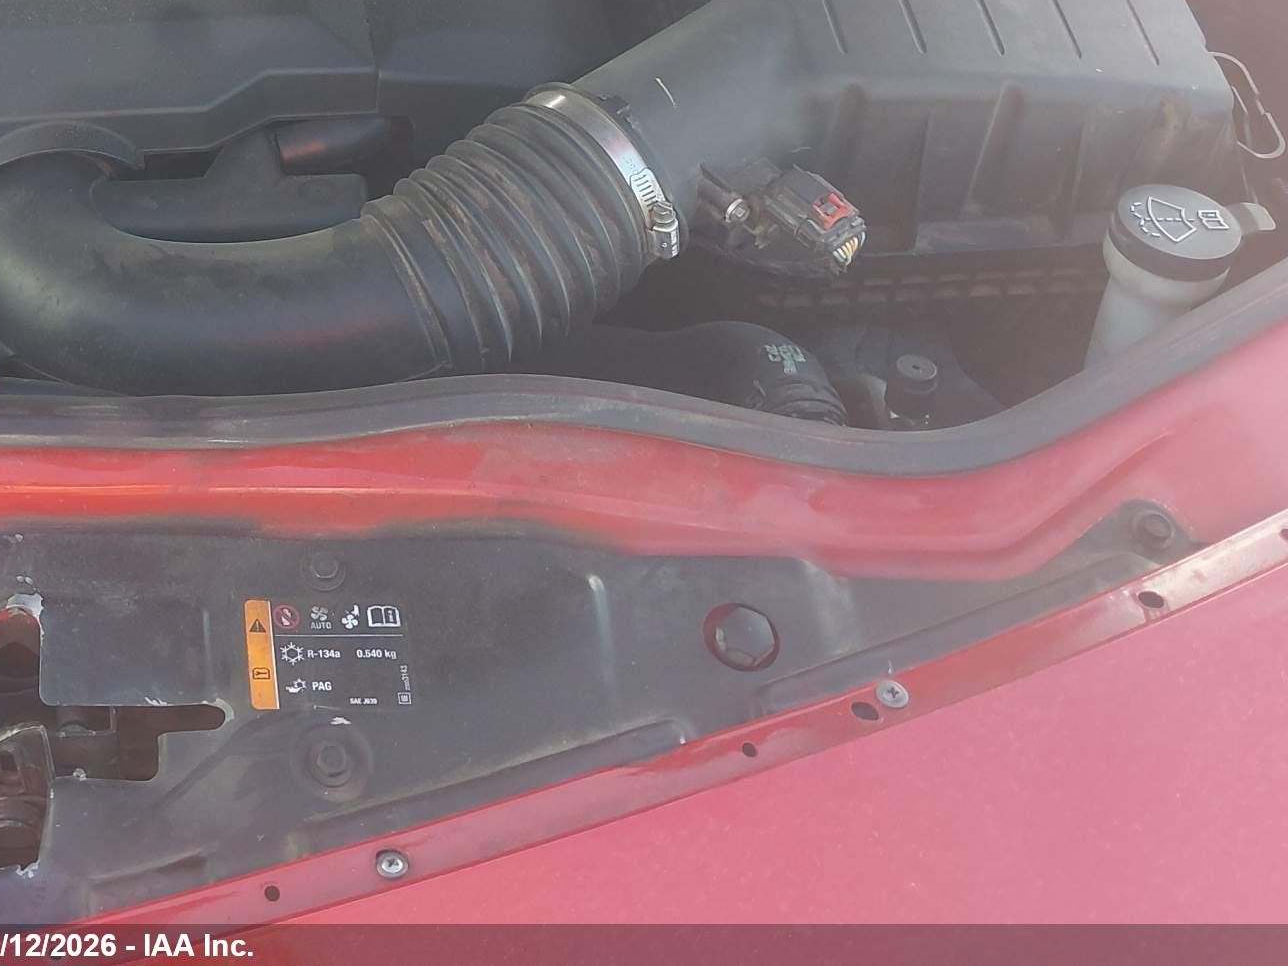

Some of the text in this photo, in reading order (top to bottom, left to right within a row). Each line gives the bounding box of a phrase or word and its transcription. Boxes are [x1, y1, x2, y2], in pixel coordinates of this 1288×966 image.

[310, 622, 332, 630] AUTO
[307, 649, 397, 660] R-134a 0.540 kg
[312, 681, 332, 691] PAG
